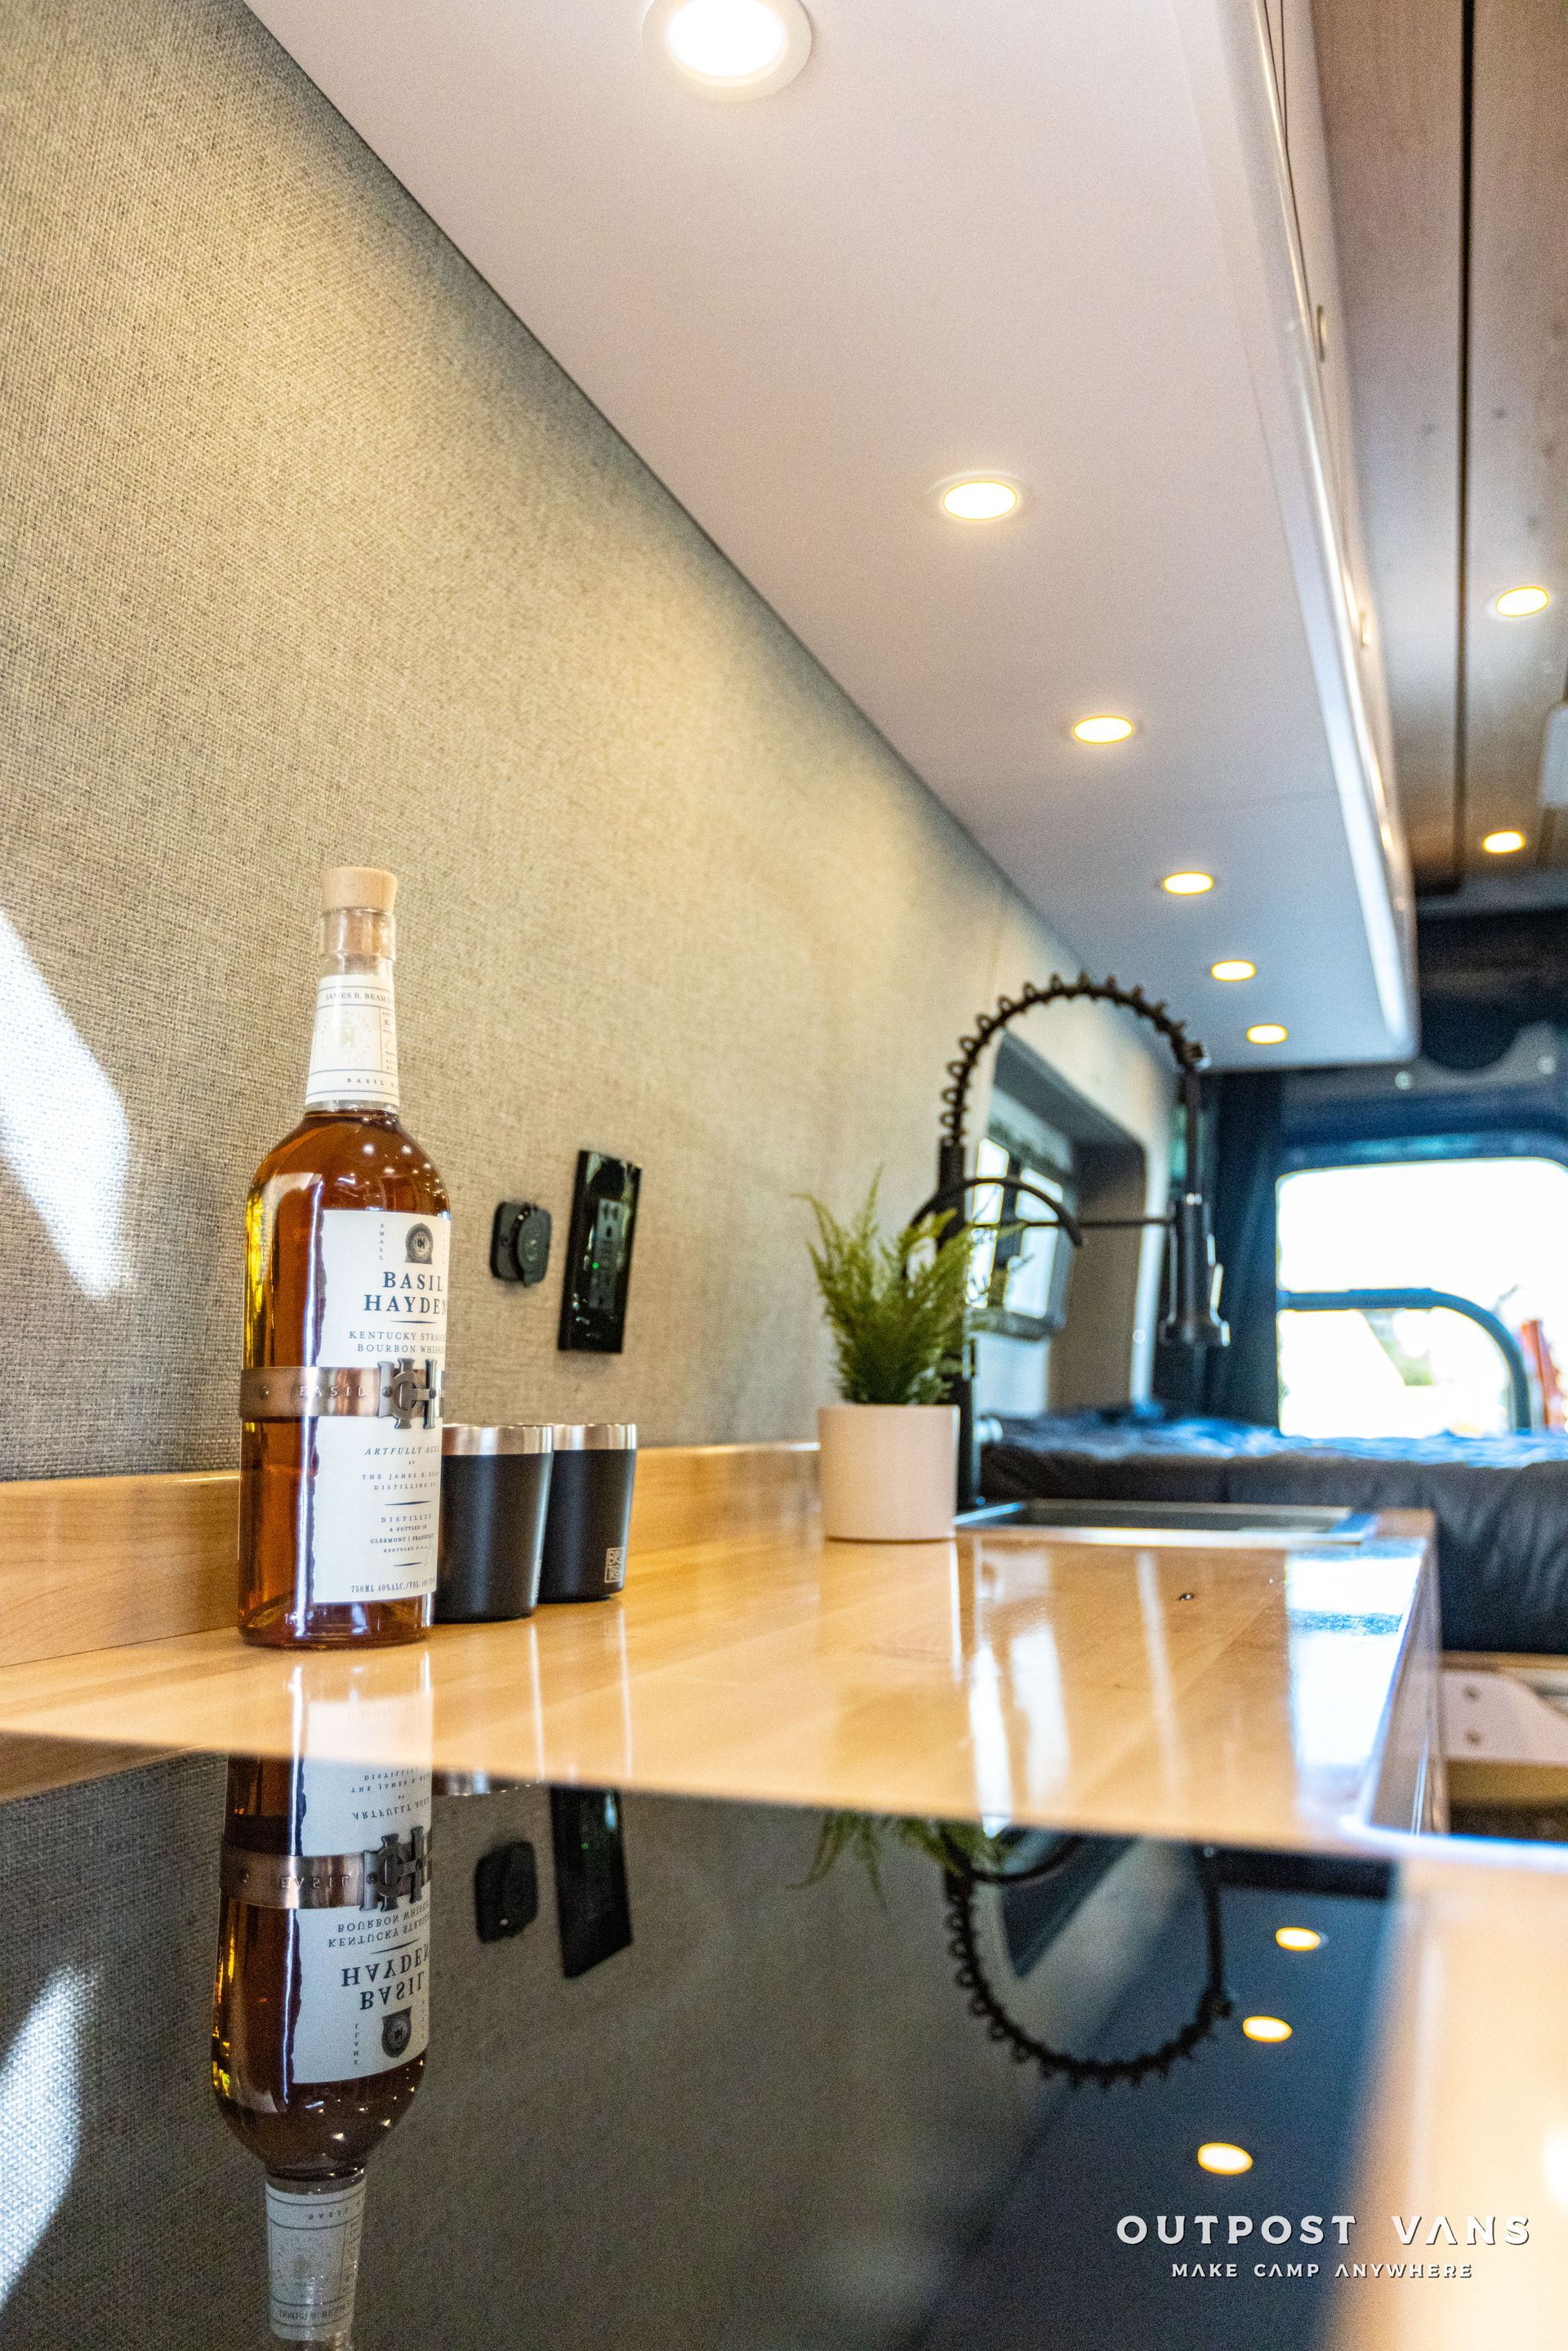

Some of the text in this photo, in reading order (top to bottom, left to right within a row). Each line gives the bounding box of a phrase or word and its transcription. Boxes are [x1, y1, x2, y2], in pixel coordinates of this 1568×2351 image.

[364, 993, 385, 1003] BEAM
[383, 1271, 443, 1291] BASIL
[364, 1294, 446, 1315] HAYDEN
[350, 1331, 416, 1340] KENTUCKY
[358, 1344, 416, 1353] BOURBON
[299, 1386, 367, 1396] BASIL
[374, 1482, 427, 1490] DISTILLING
[351, 1585, 374, 1593] 750ML
